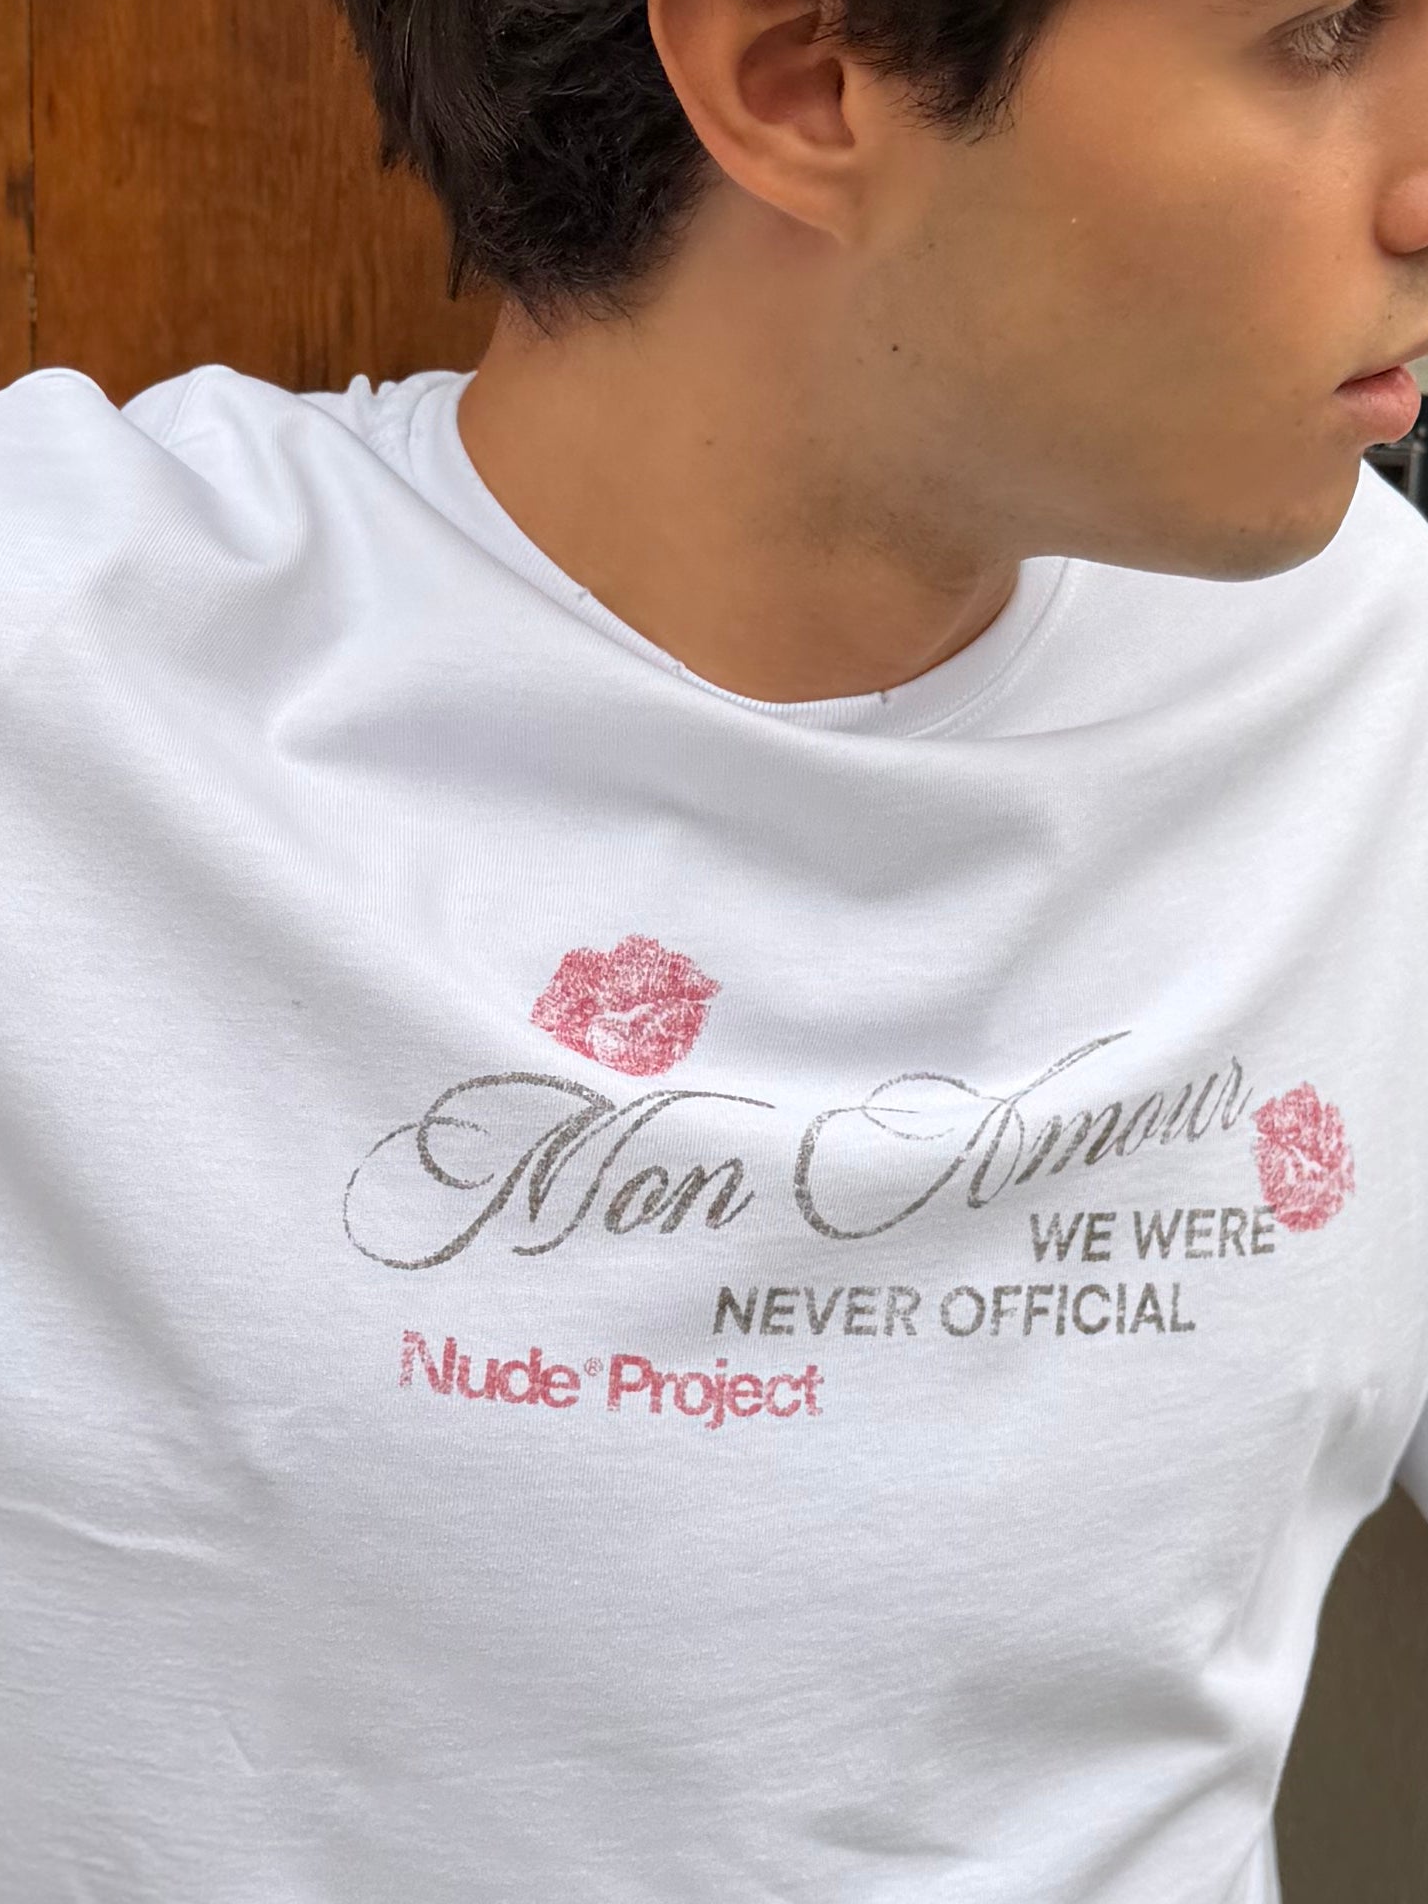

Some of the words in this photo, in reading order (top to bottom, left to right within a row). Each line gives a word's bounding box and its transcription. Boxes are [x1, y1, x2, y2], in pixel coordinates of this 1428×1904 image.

[343, 1071, 776, 1271] Mon
[793, 1030, 1255, 1240] Amour
[1029, 1210, 1117, 1264] WE
[1132, 1205, 1276, 1261] WERE
[712, 1285, 922, 1336] NEVER
[939, 1281, 1197, 1338] OFFICIAL
[606, 1353, 825, 1431] Project
